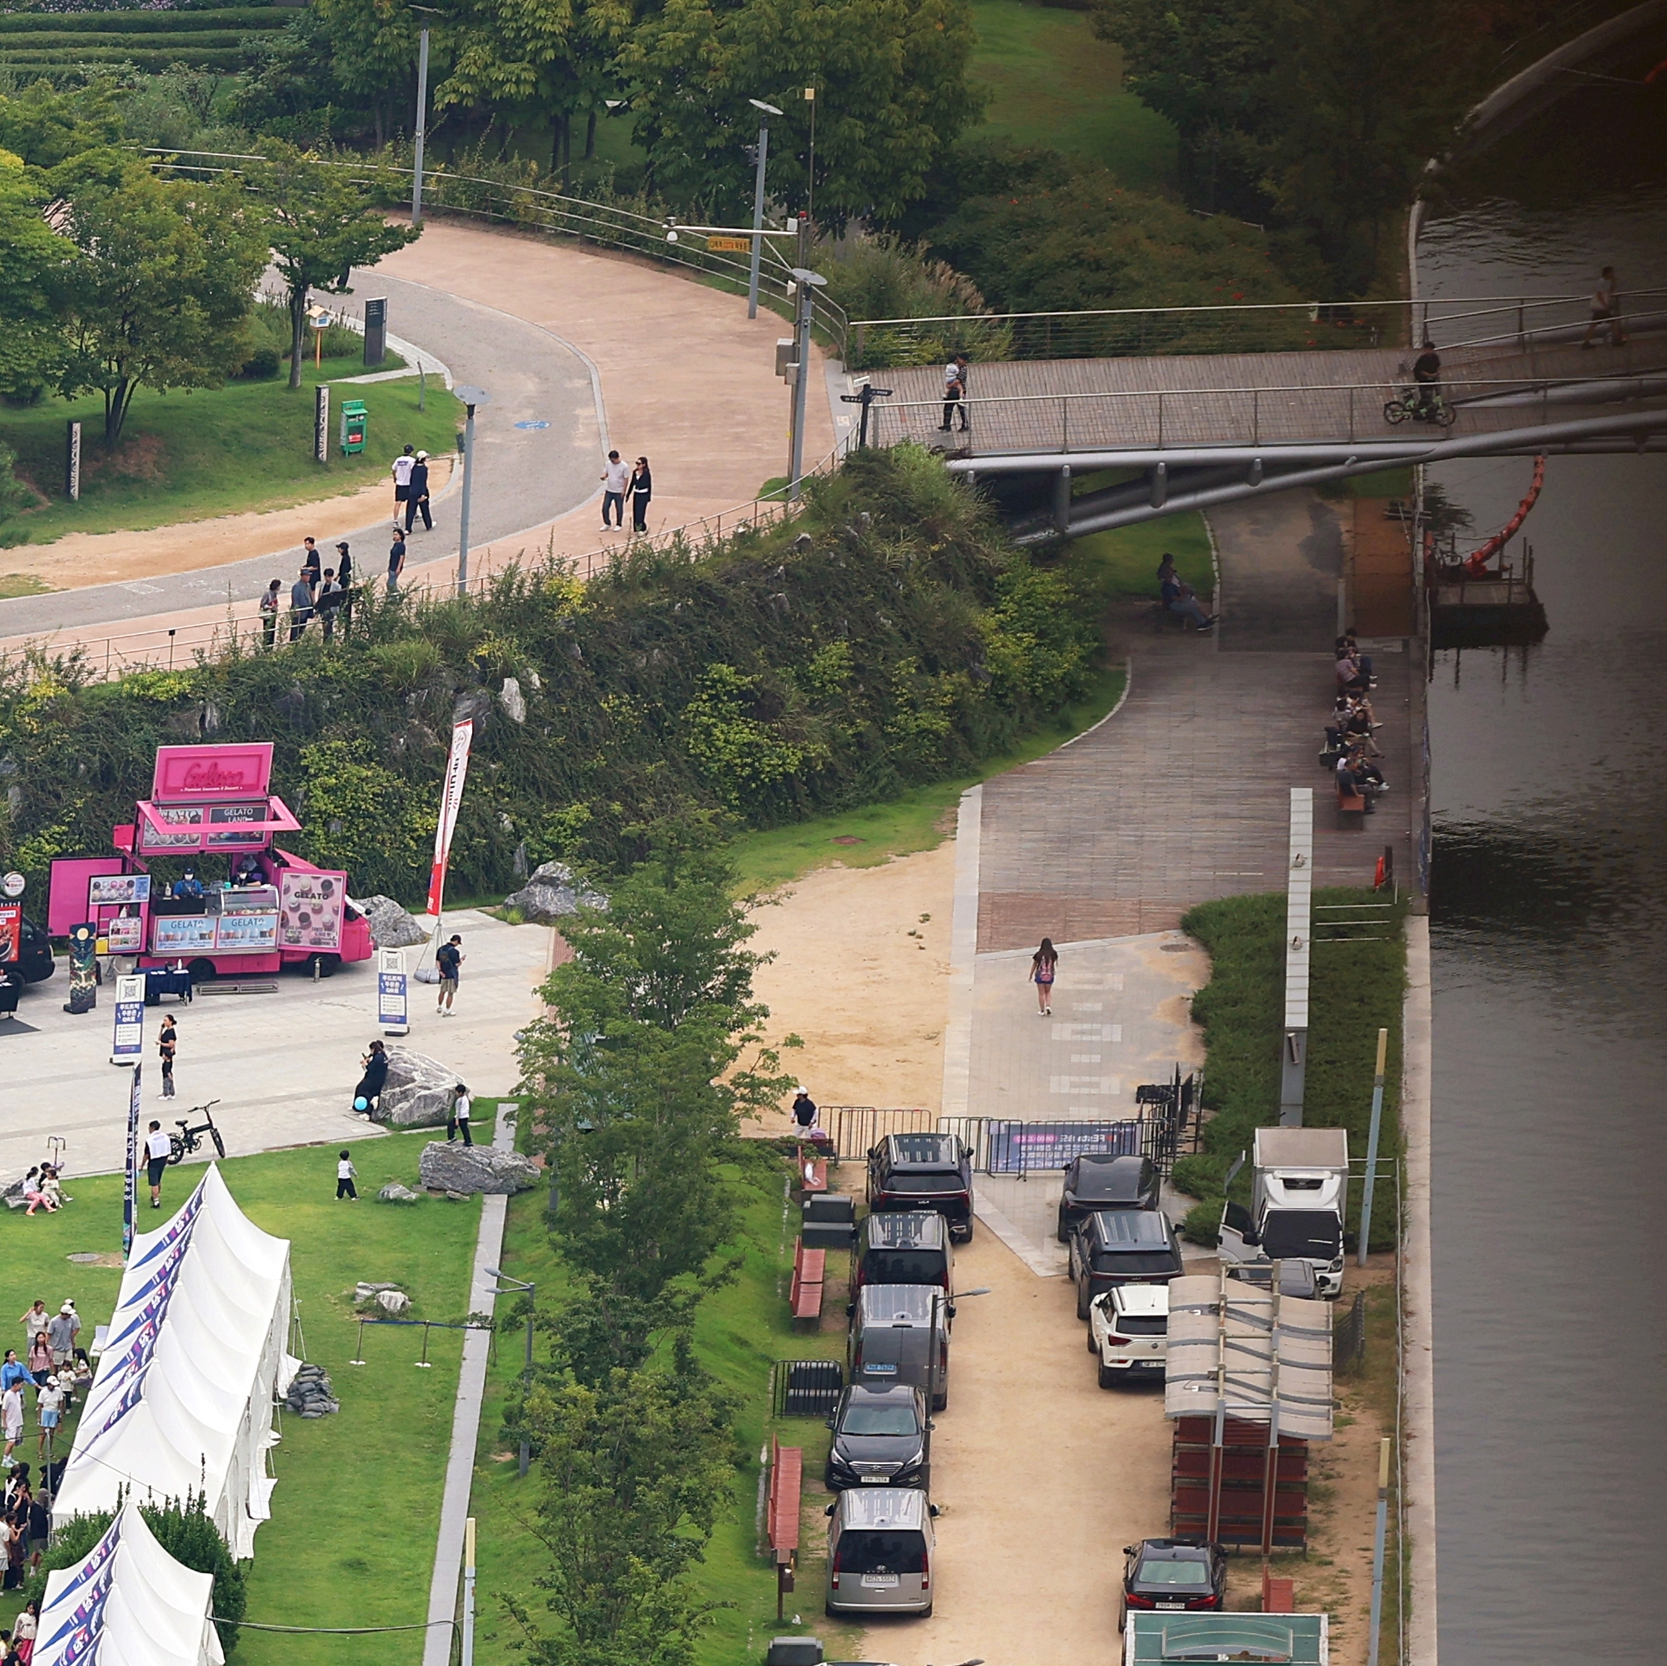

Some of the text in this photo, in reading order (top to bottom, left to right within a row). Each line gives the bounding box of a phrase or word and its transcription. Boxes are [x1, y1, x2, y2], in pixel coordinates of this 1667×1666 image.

[224, 808, 253, 816] GELATO
[294, 891, 329, 900] GELATO
[170, 919, 204, 929] GELATO
[231, 917, 265, 927] GELATO
